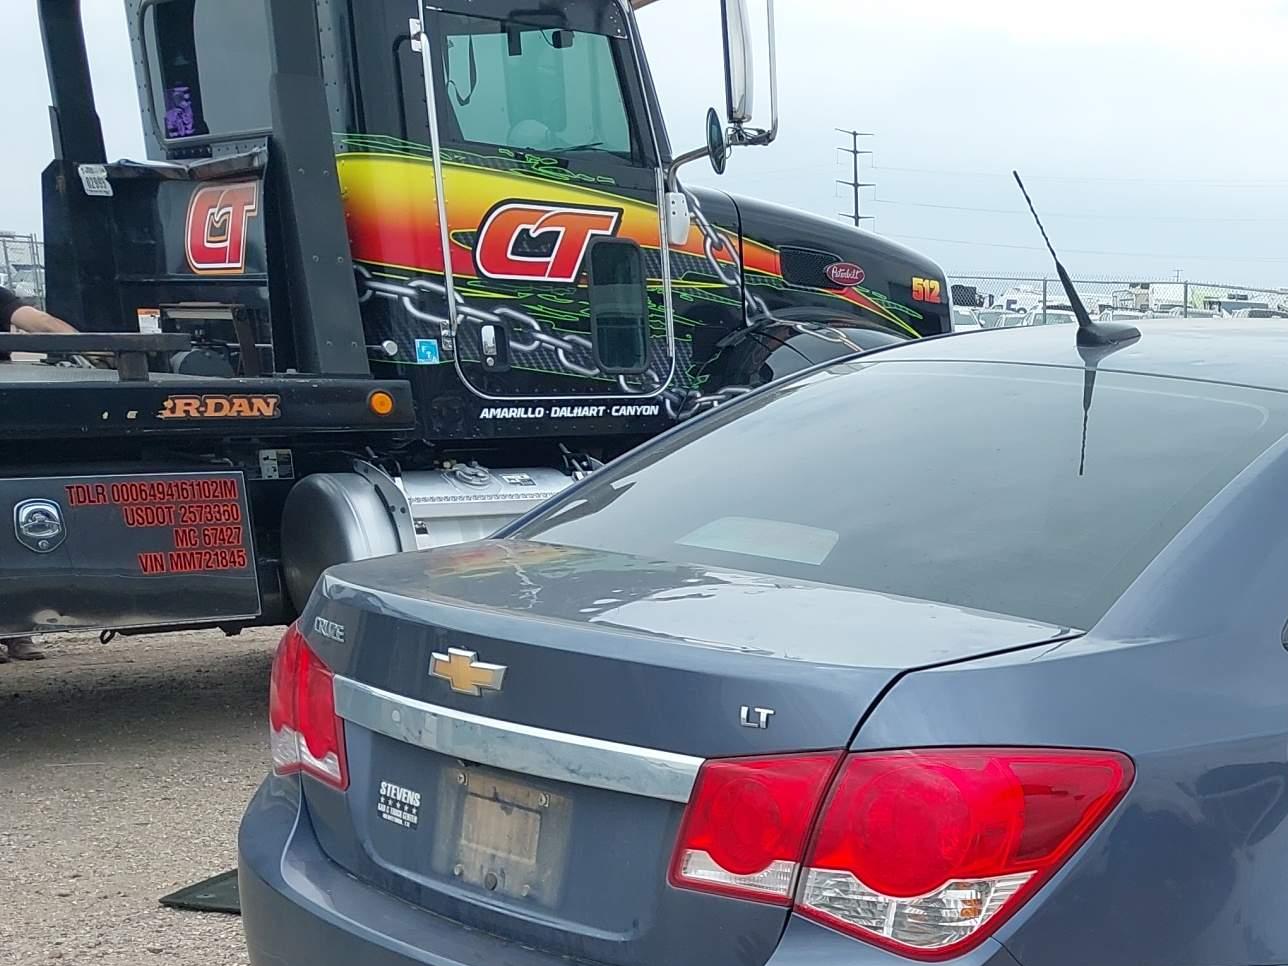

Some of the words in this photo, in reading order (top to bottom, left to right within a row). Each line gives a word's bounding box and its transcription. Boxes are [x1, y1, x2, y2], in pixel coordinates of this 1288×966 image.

[185, 182, 258, 275] CT
[474, 201, 623, 283] CT
[912, 276, 940, 304] 512
[480, 407, 544, 419] AMARILLO
[550, 406, 605, 418] DALHART
[611, 405, 660, 417] CANYON
[65, 485, 107, 506] TDLR
[123, 505, 174, 527] USDOT
[180, 503, 240, 524] 2573360
[174, 528, 198, 548] MC
[203, 526, 241, 546] 67427
[138, 552, 165, 574] VIN
[169, 549, 247, 571] MM721845
[740, 705, 775, 729] LT
[380, 781, 420, 807] STEVENS
